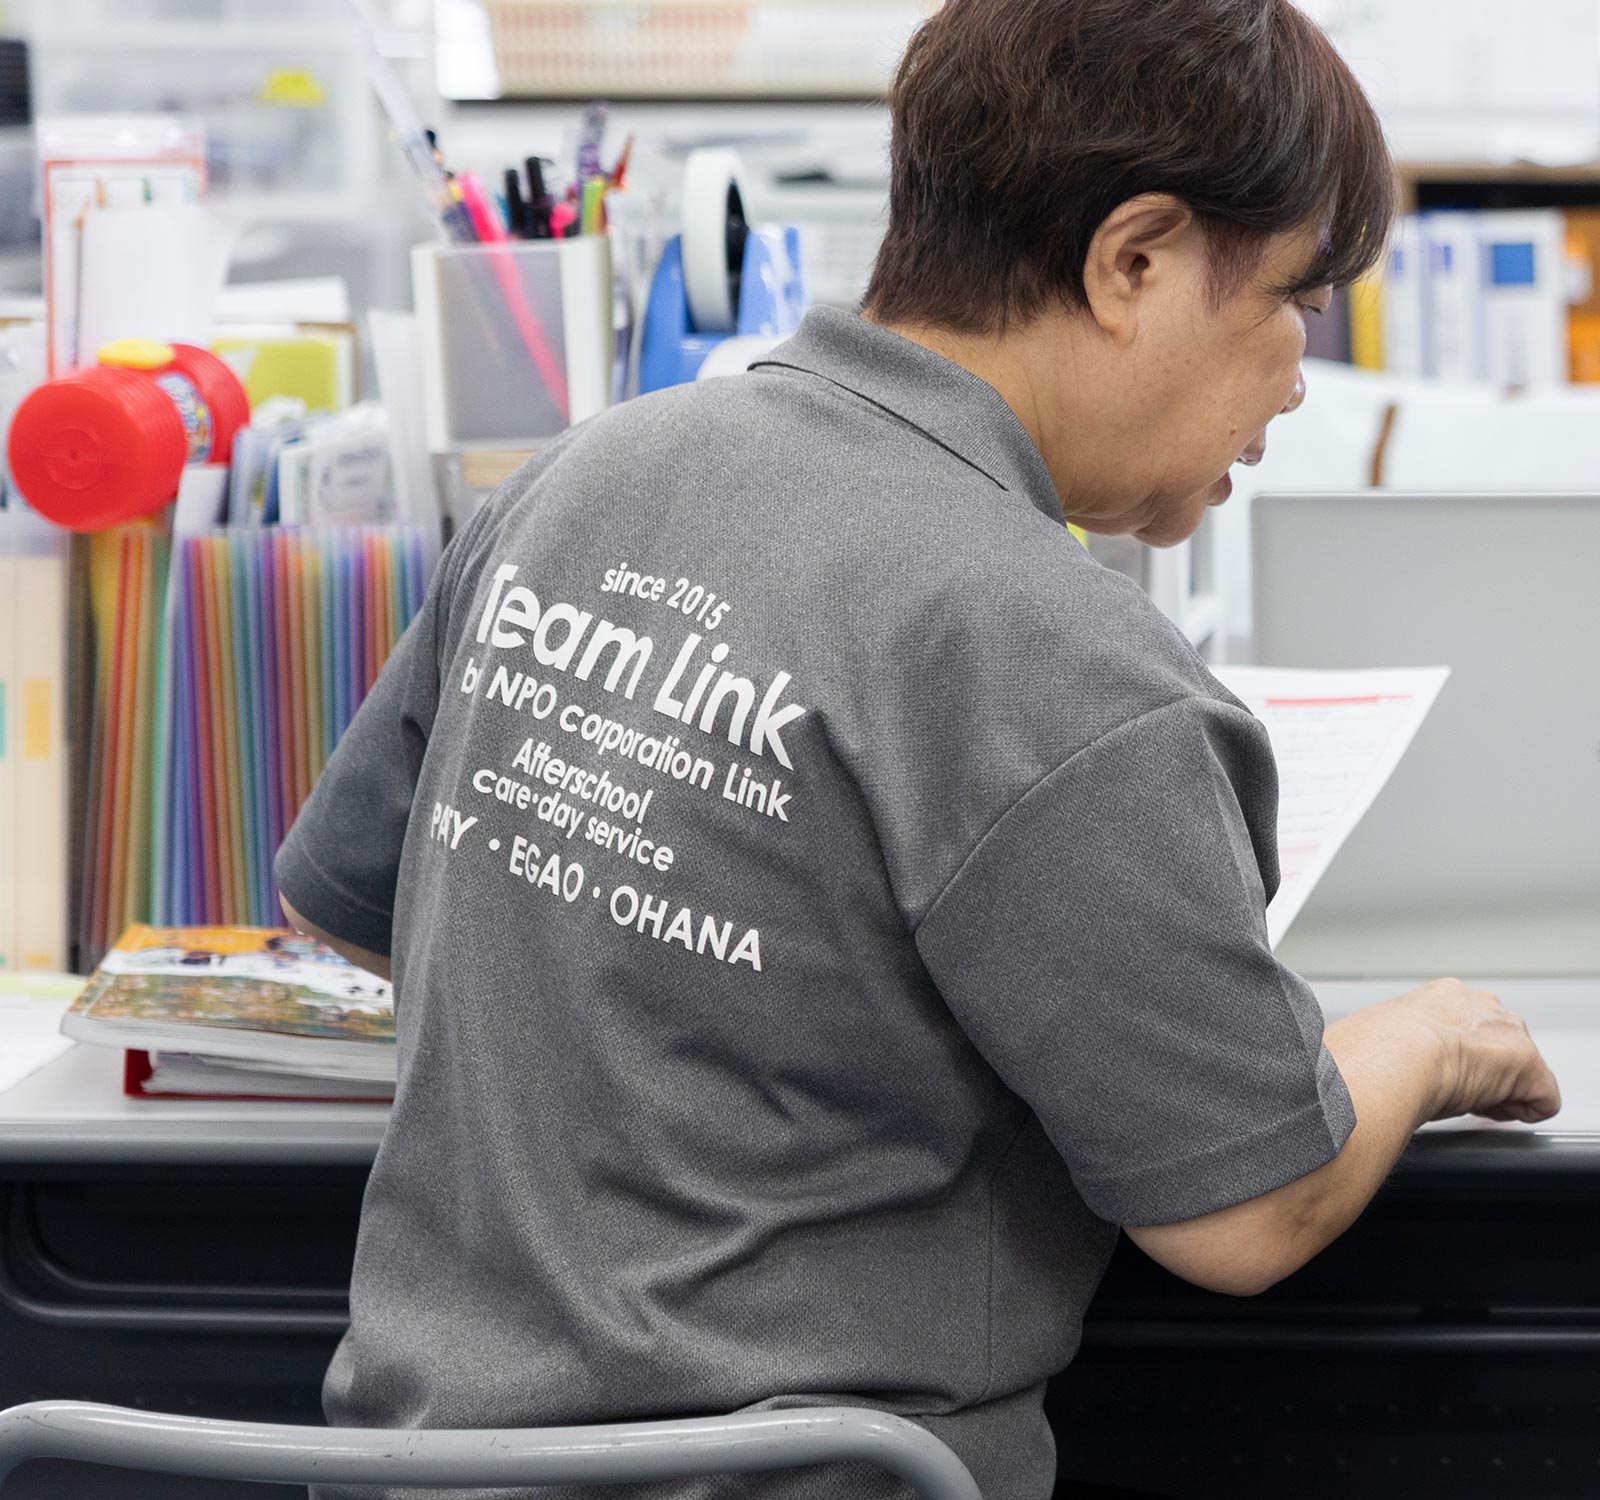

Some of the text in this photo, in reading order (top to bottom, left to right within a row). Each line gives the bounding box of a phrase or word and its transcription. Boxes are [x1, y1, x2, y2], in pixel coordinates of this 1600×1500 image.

[600, 562, 732, 631] since 2015
[476, 564, 807, 772] Team Link
[460, 657, 793, 823] b NPO corporation Link
[511, 738, 654, 824] Afterschool
[585, 817, 675, 871] service
[509, 835, 585, 903] EGAO
[610, 885, 763, 972] OHANA
